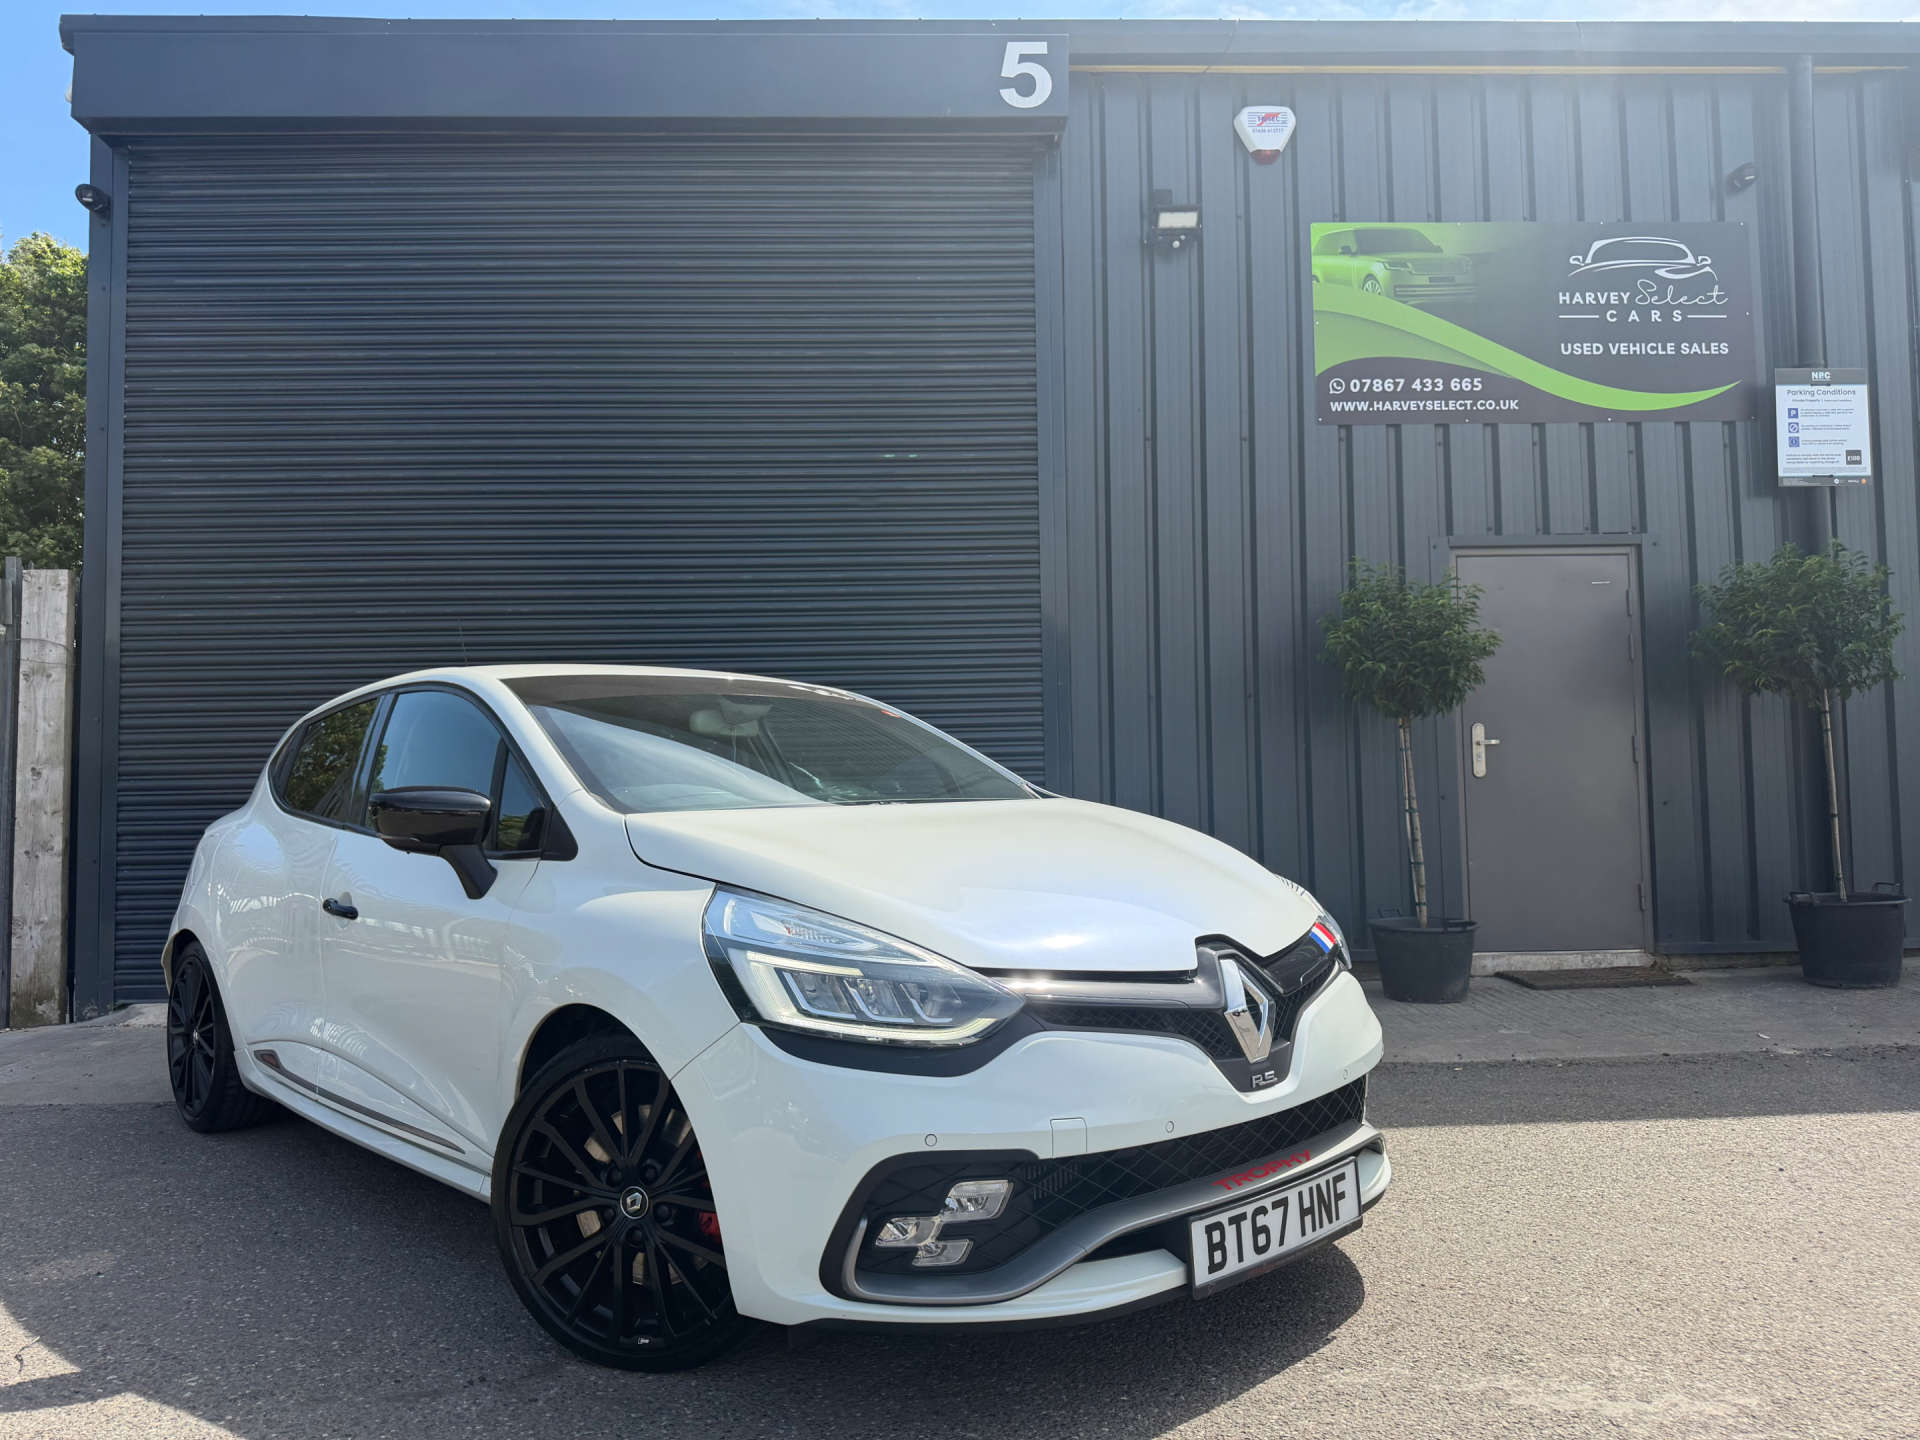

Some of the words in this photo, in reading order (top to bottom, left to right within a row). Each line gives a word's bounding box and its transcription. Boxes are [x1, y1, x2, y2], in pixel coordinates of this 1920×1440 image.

[1000, 41, 1052, 108] 5
[1558, 291, 1631, 305] HARVEY
[1635, 279, 1729, 305] Select
[1606, 310, 1683, 323] CARS
[1560, 342, 1603, 355] USED
[1608, 342, 1675, 355] VEHICLE
[1680, 342, 1729, 355] SALES
[1811, 371, 1831, 379] NPC
[1350, 379, 1405, 392] 07867
[1411, 378, 1444, 392] 433
[1450, 378, 1483, 391] 665
[1786, 389, 1815, 397] Parking
[1816, 388, 1856, 396] Conditions
[1330, 400, 1519, 412] WWW.HARVEYSELECT.CO.UK
[1213, 1150, 1312, 1191] TROPHY
[1205, 1197, 1289, 1275] BT67
[1298, 1172, 1346, 1238] HNF
